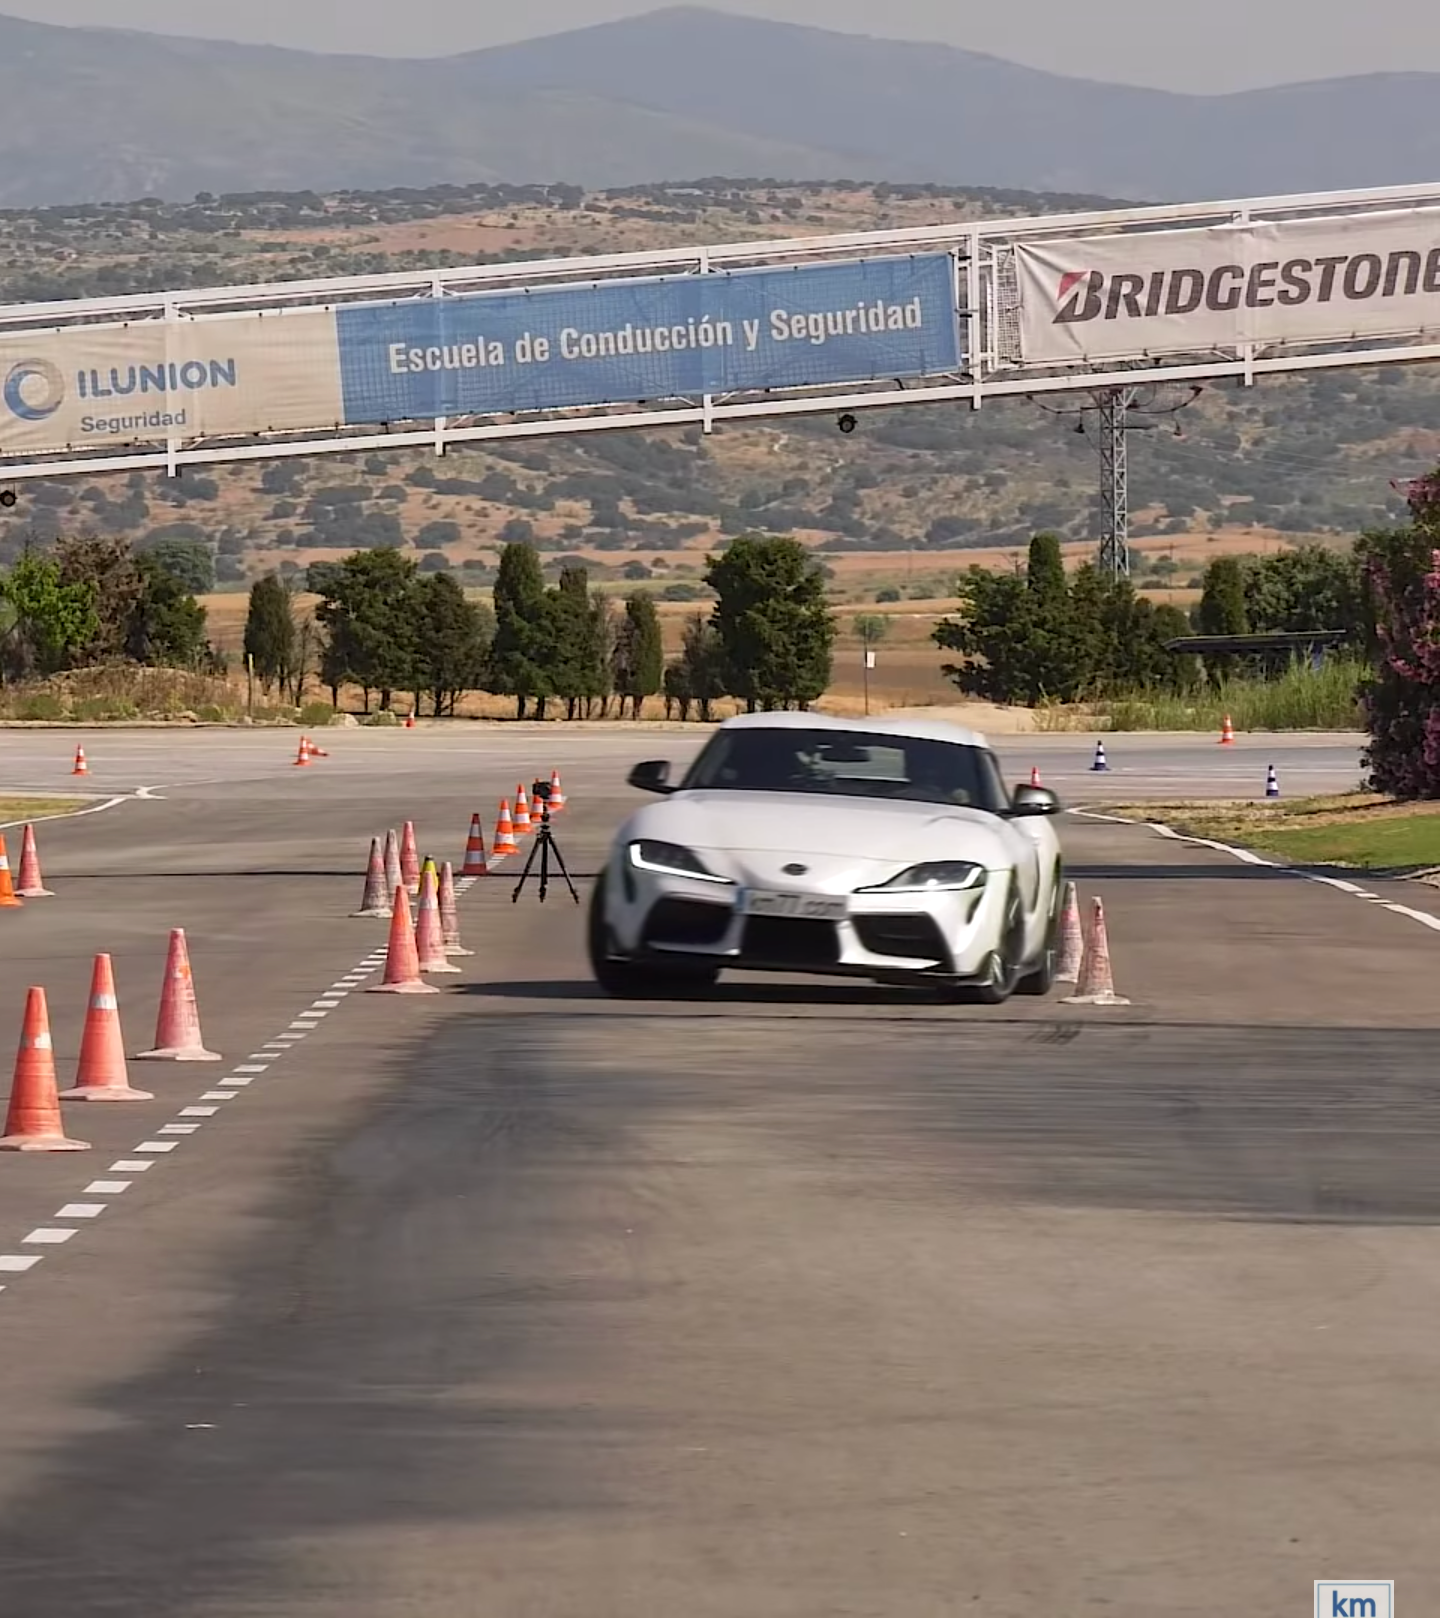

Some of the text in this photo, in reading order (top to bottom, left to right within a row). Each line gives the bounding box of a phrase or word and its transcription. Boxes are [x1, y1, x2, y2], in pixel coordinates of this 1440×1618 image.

[388, 297, 922, 374] Escuela de Conducción y Seguridad
[77, 358, 237, 398] ILUNION
[80, 408, 187, 434] Seguridad
